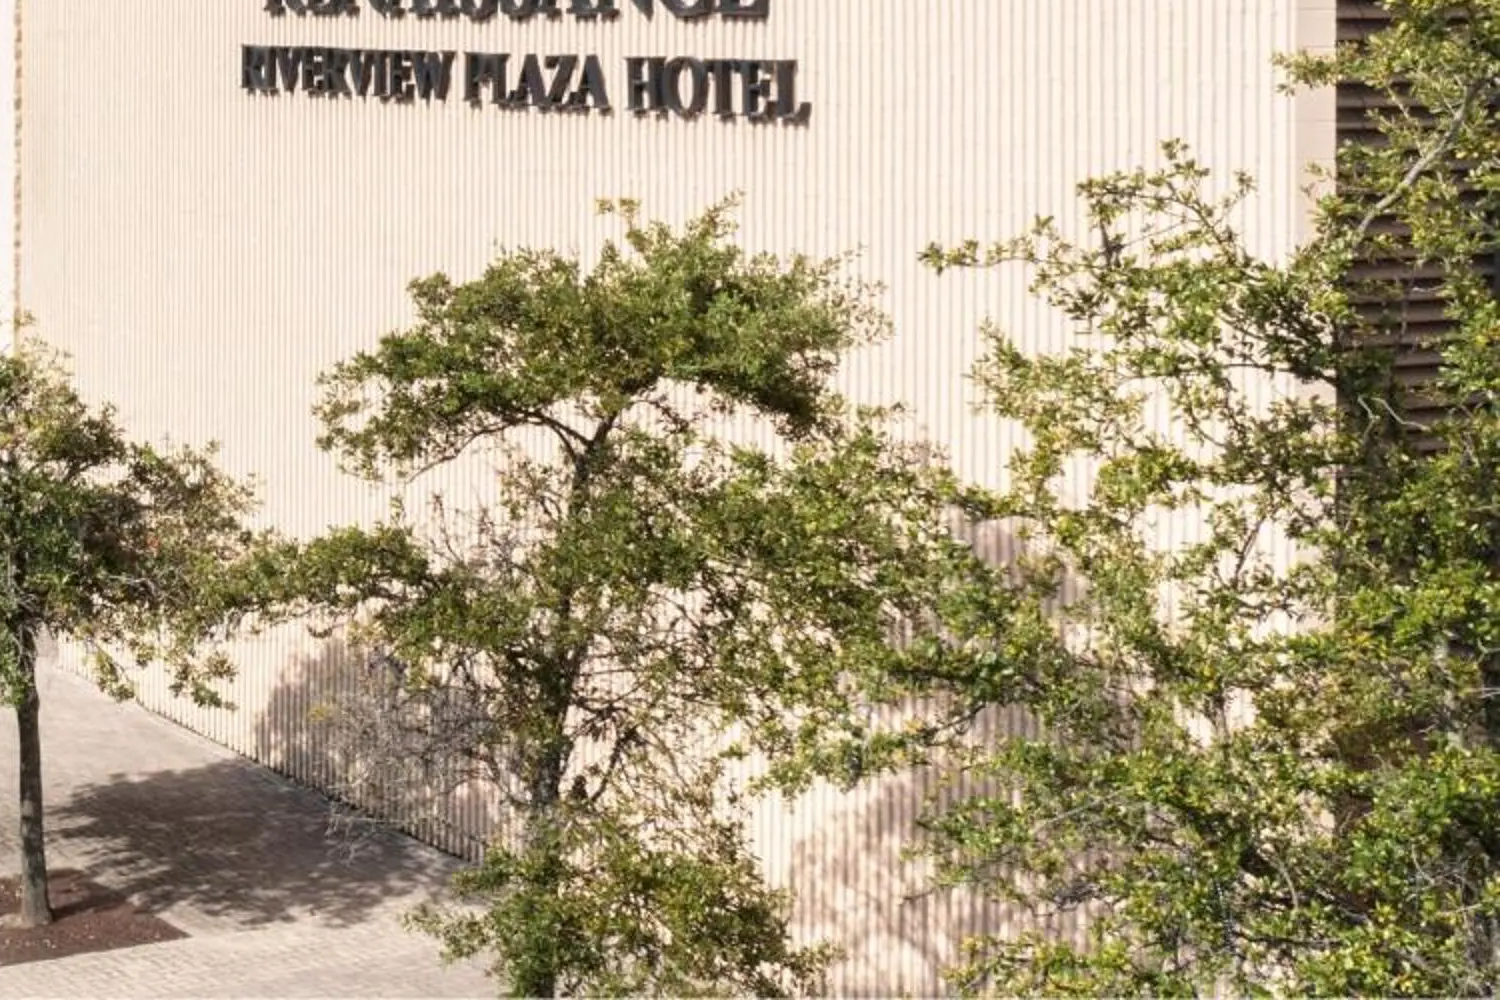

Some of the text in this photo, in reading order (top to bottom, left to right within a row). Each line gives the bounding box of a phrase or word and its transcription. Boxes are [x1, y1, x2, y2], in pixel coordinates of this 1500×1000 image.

[240, 43, 813, 125] RIVERVIEW PLAZA HOTEL
